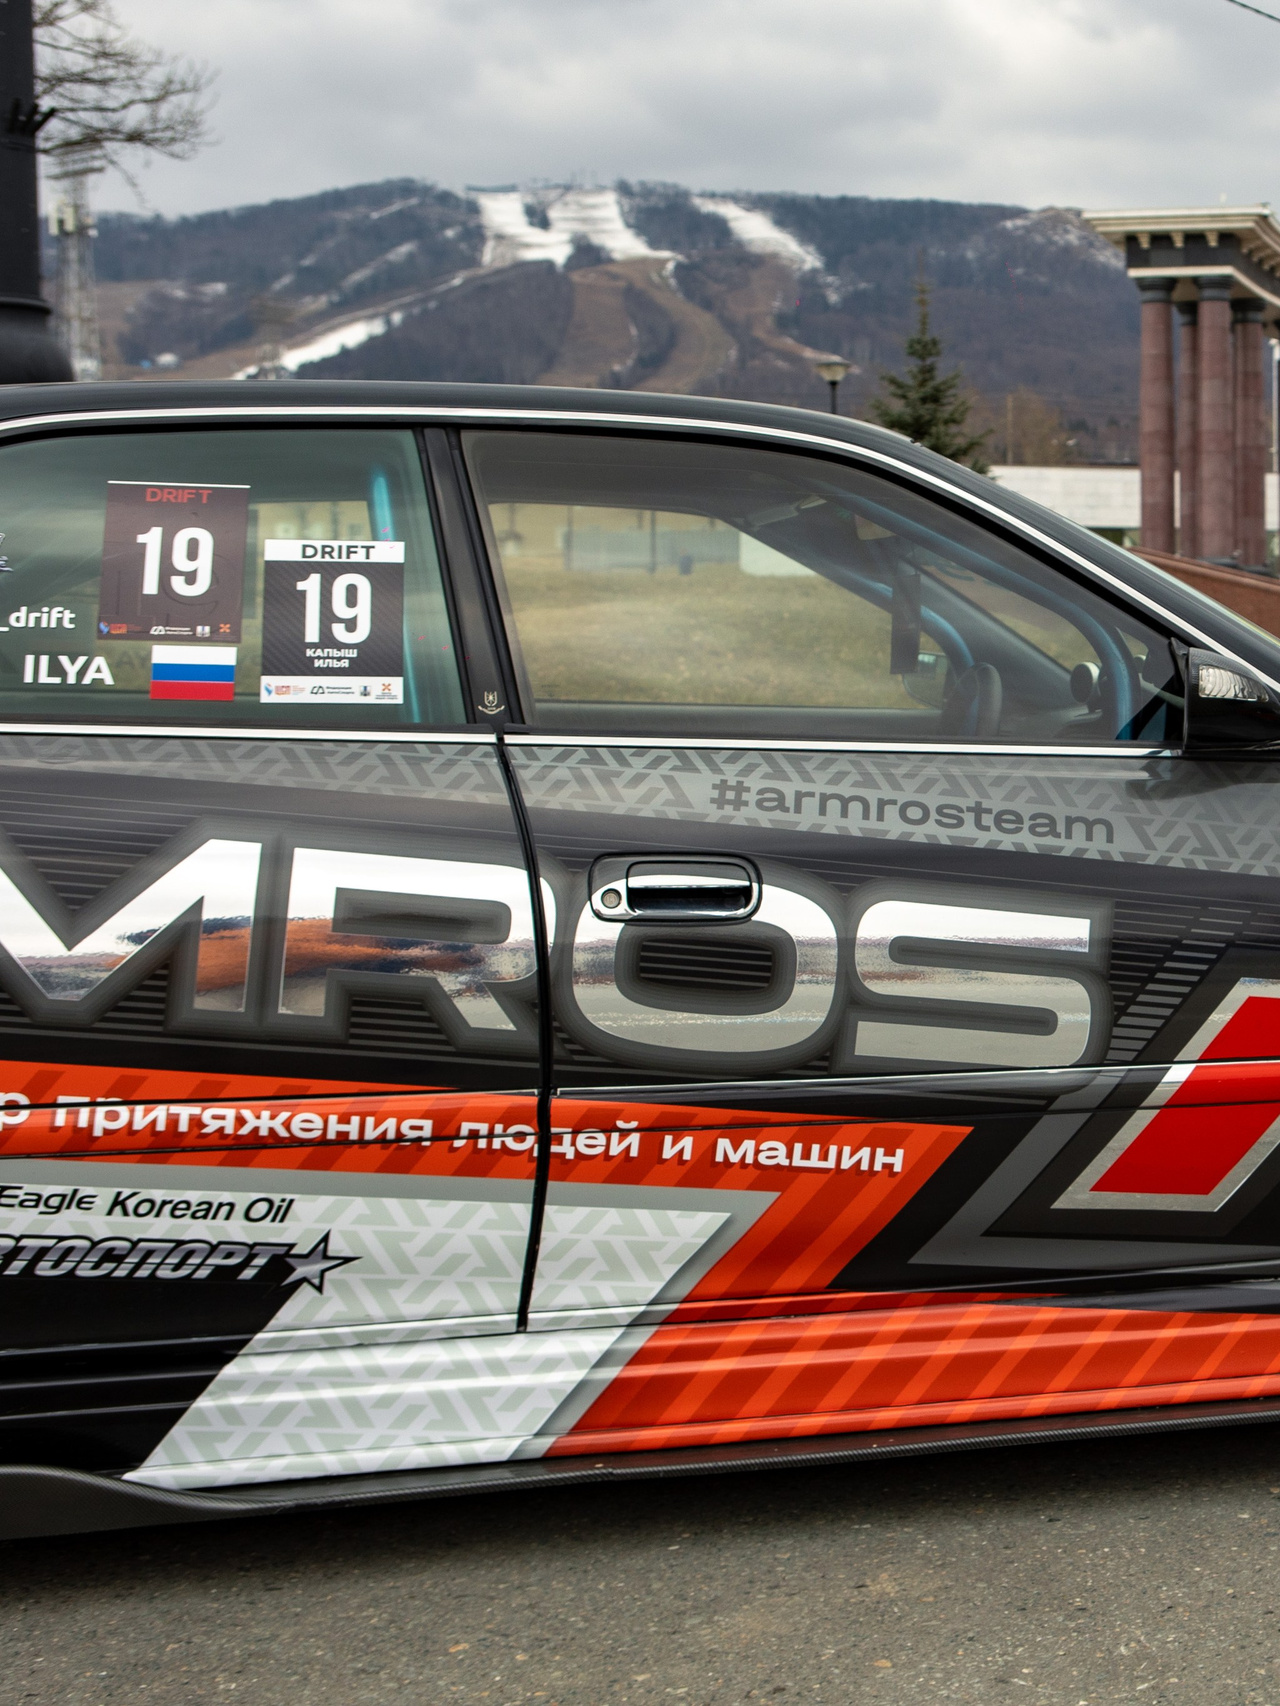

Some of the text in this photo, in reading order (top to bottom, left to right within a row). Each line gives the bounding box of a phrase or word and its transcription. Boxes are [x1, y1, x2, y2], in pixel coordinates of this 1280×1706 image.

[145, 487, 213, 504] DRIFT
[136, 526, 214, 597] 19
[301, 544, 375, 560] DRIFT
[296, 573, 372, 644] 19
[305, 648, 358, 658] КАПЫШ
[313, 658, 350, 668] ИЛЬЯ
[23, 654, 115, 685] ILYA
[710, 778, 1115, 844] #armrosteam
[54, 1095, 433, 1147] притяжения
[452, 1119, 641, 1160] людей
[662, 1136, 693, 1160] и
[714, 1136, 905, 1172] машин
[106, 1190, 235, 1222] Korean
[242, 1197, 295, 1223] Oil
